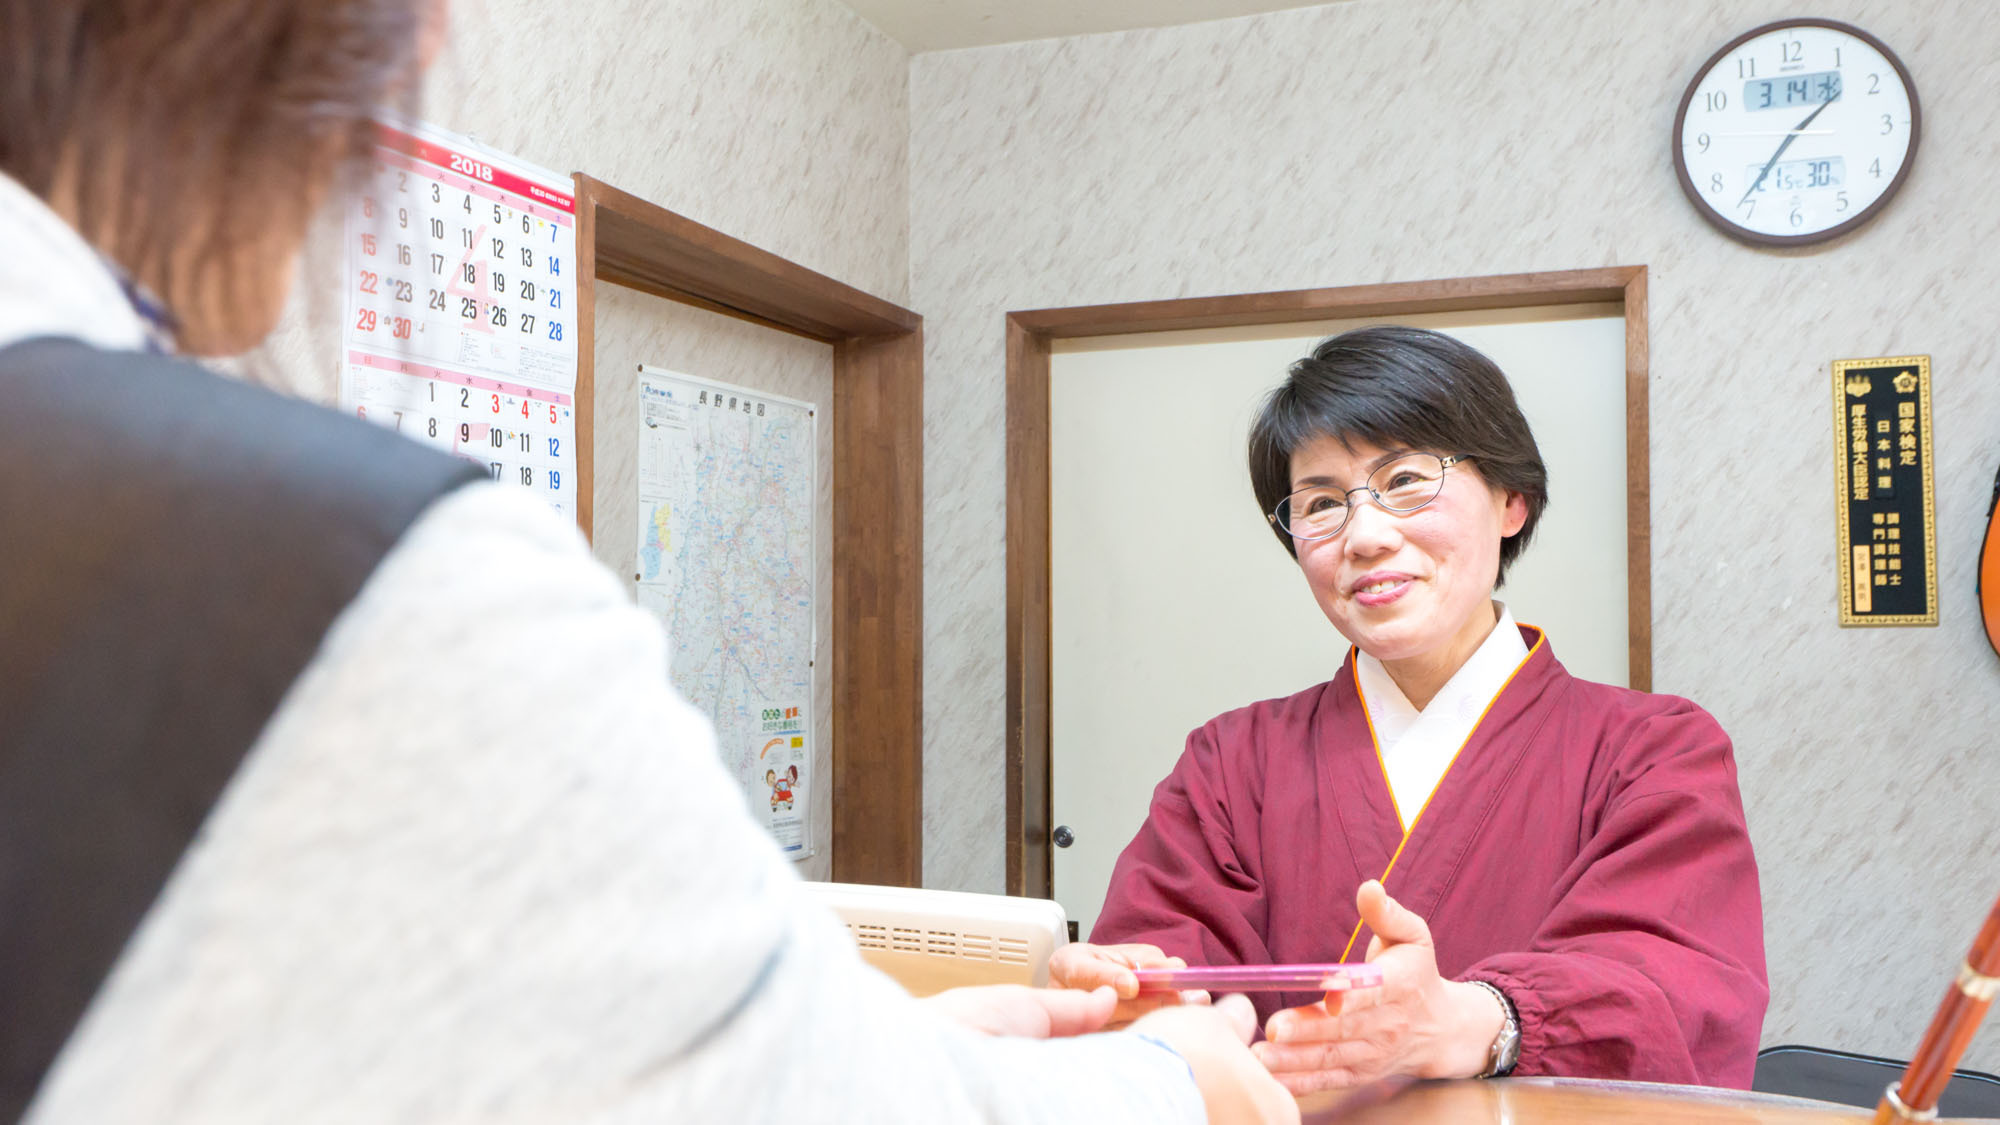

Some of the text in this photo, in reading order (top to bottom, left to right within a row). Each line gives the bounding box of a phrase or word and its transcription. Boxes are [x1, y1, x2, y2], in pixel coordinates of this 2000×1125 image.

[1781, 40, 1803, 64] 12
[1834, 47, 1841, 68] 1
[1738, 57, 1756, 79] 11
[1760, 75, 1841, 109] 3 14 水
[1867, 73, 1880, 96] 2
[1705, 91, 1727, 112] 10
[1880, 114, 1893, 135] 3
[1698, 133, 1711, 154] 9
[450, 153, 494, 182] 2018
[1868, 157, 1882, 179] 4
[1711, 172, 1724, 193] 8
[398, 172, 558, 243] 2 3 4 5 6 7
[1744, 199, 1757, 221] 7
[1836, 190, 1848, 213] 5
[1790, 206, 1803, 228] 6
[399, 208, 408, 229] 9
[430, 217, 444, 240] 10
[462, 228, 473, 250] 11
[492, 238, 505, 259] 12
[521, 247, 532, 268] 13
[549, 256, 560, 277] 14
[361, 232, 561, 309] 15 16 17 18 19 20 21
[359, 270, 562, 342] 22 23 24 25 26 27 28
[357, 308, 412, 340] 29 30
[429, 381, 557, 424] 1 2 3 4 5
[699, 390, 766, 417] 長野県地図
[393, 411, 403, 432] 7
[429, 417, 437, 438] 8
[461, 423, 469, 443] 9
[490, 428, 503, 448] 10
[520, 433, 530, 453] 11
[548, 438, 560, 457] 12
[1898, 401, 1917, 466] 国家検定
[1877, 420, 1892, 489] 日本料理
[490, 462, 560, 490] 17 18 19
